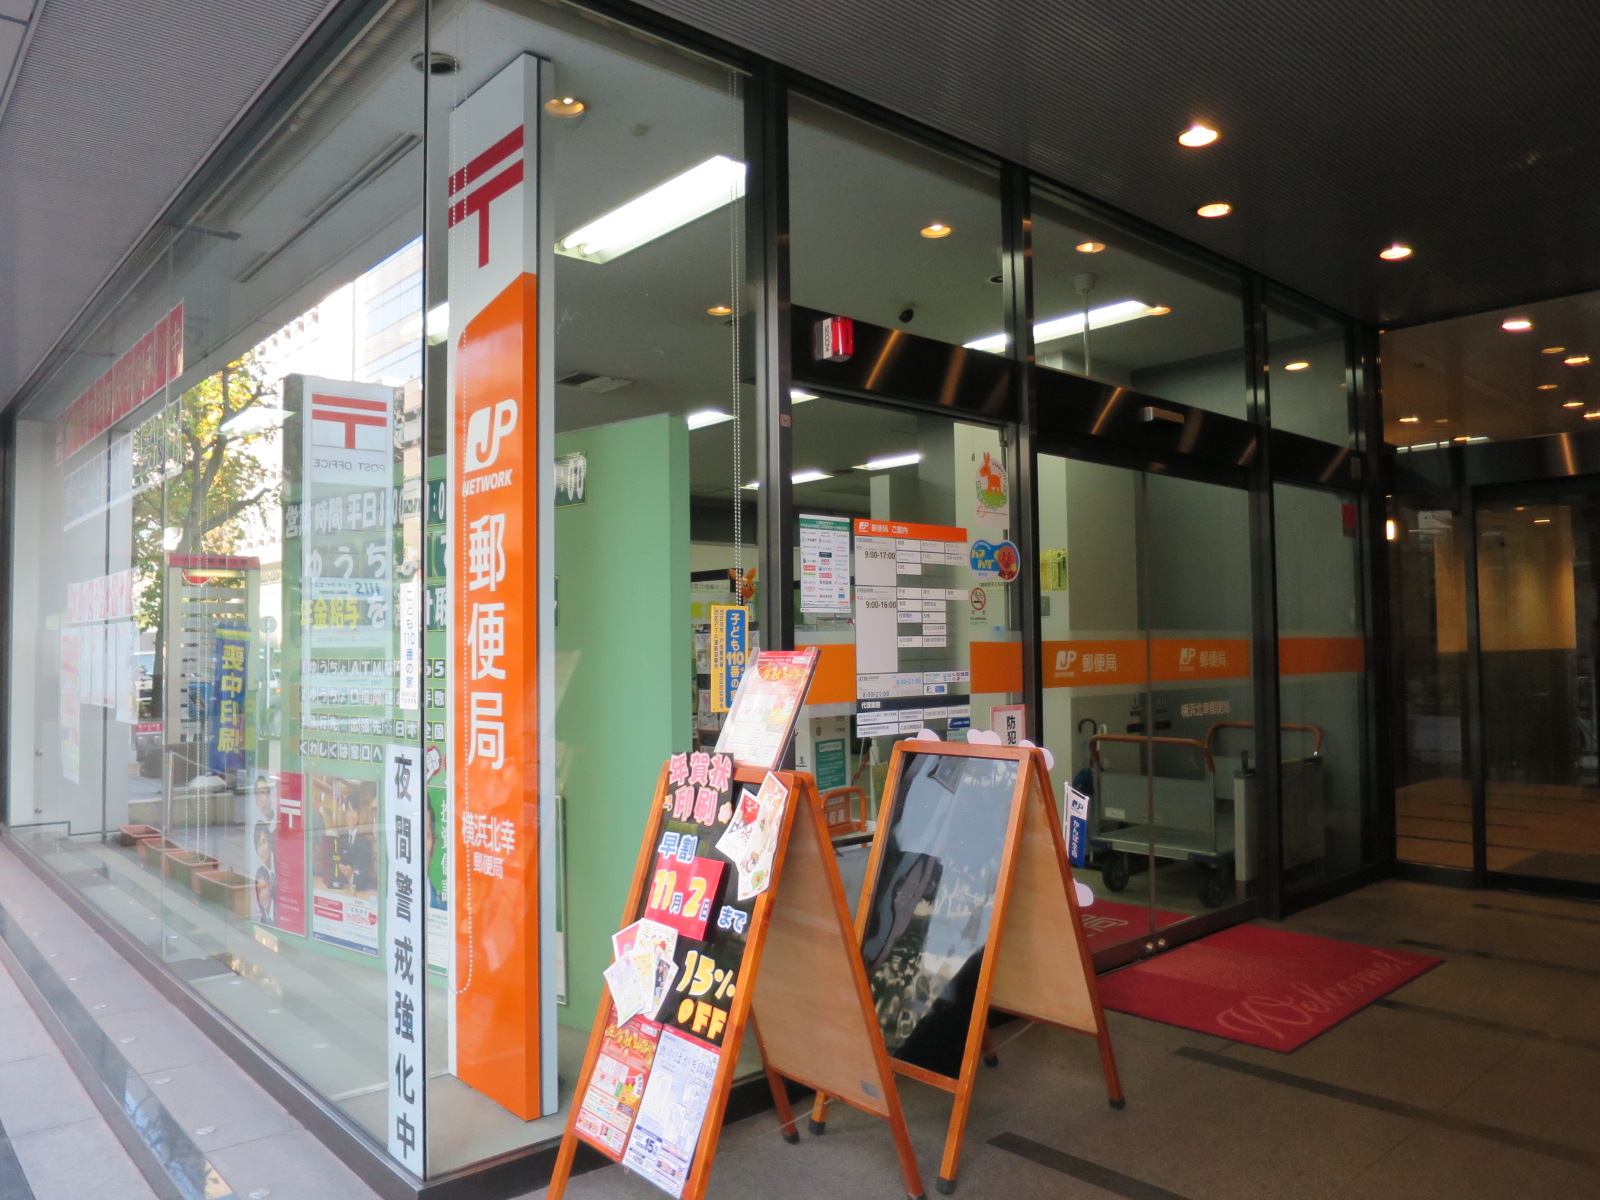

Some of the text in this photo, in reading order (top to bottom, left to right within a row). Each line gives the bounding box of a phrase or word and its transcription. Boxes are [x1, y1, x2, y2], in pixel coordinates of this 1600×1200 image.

[465, 398, 519, 474] JP
[462, 468, 513, 497] NETWORK
[891, 525, 909, 535] ご案内
[864, 550, 896, 560] 9:00-17:00
[865, 600, 897, 609] 9:00-16:00
[467, 513, 507, 771] 郵便局
[1082, 653, 1117, 673] 郵便局
[1199, 650, 1227, 668] 郵便局
[1181, 700, 1230, 718] 横浜北幸郵便局
[1006, 715, 1017, 745] 防犯
[669, 750, 732, 793] 年賀状
[672, 785, 719, 827] 印刷
[461, 811, 516, 856] 横浜北幸
[657, 831, 699, 864] 早割
[473, 851, 505, 880] 郵便局
[650, 869, 711, 922] 11月2日
[717, 905, 748, 934] まで
[393, 753, 417, 1160] 夜間警戒強化中
[675, 950, 737, 1000] 15%
[677, 997, 728, 1040] OFF
